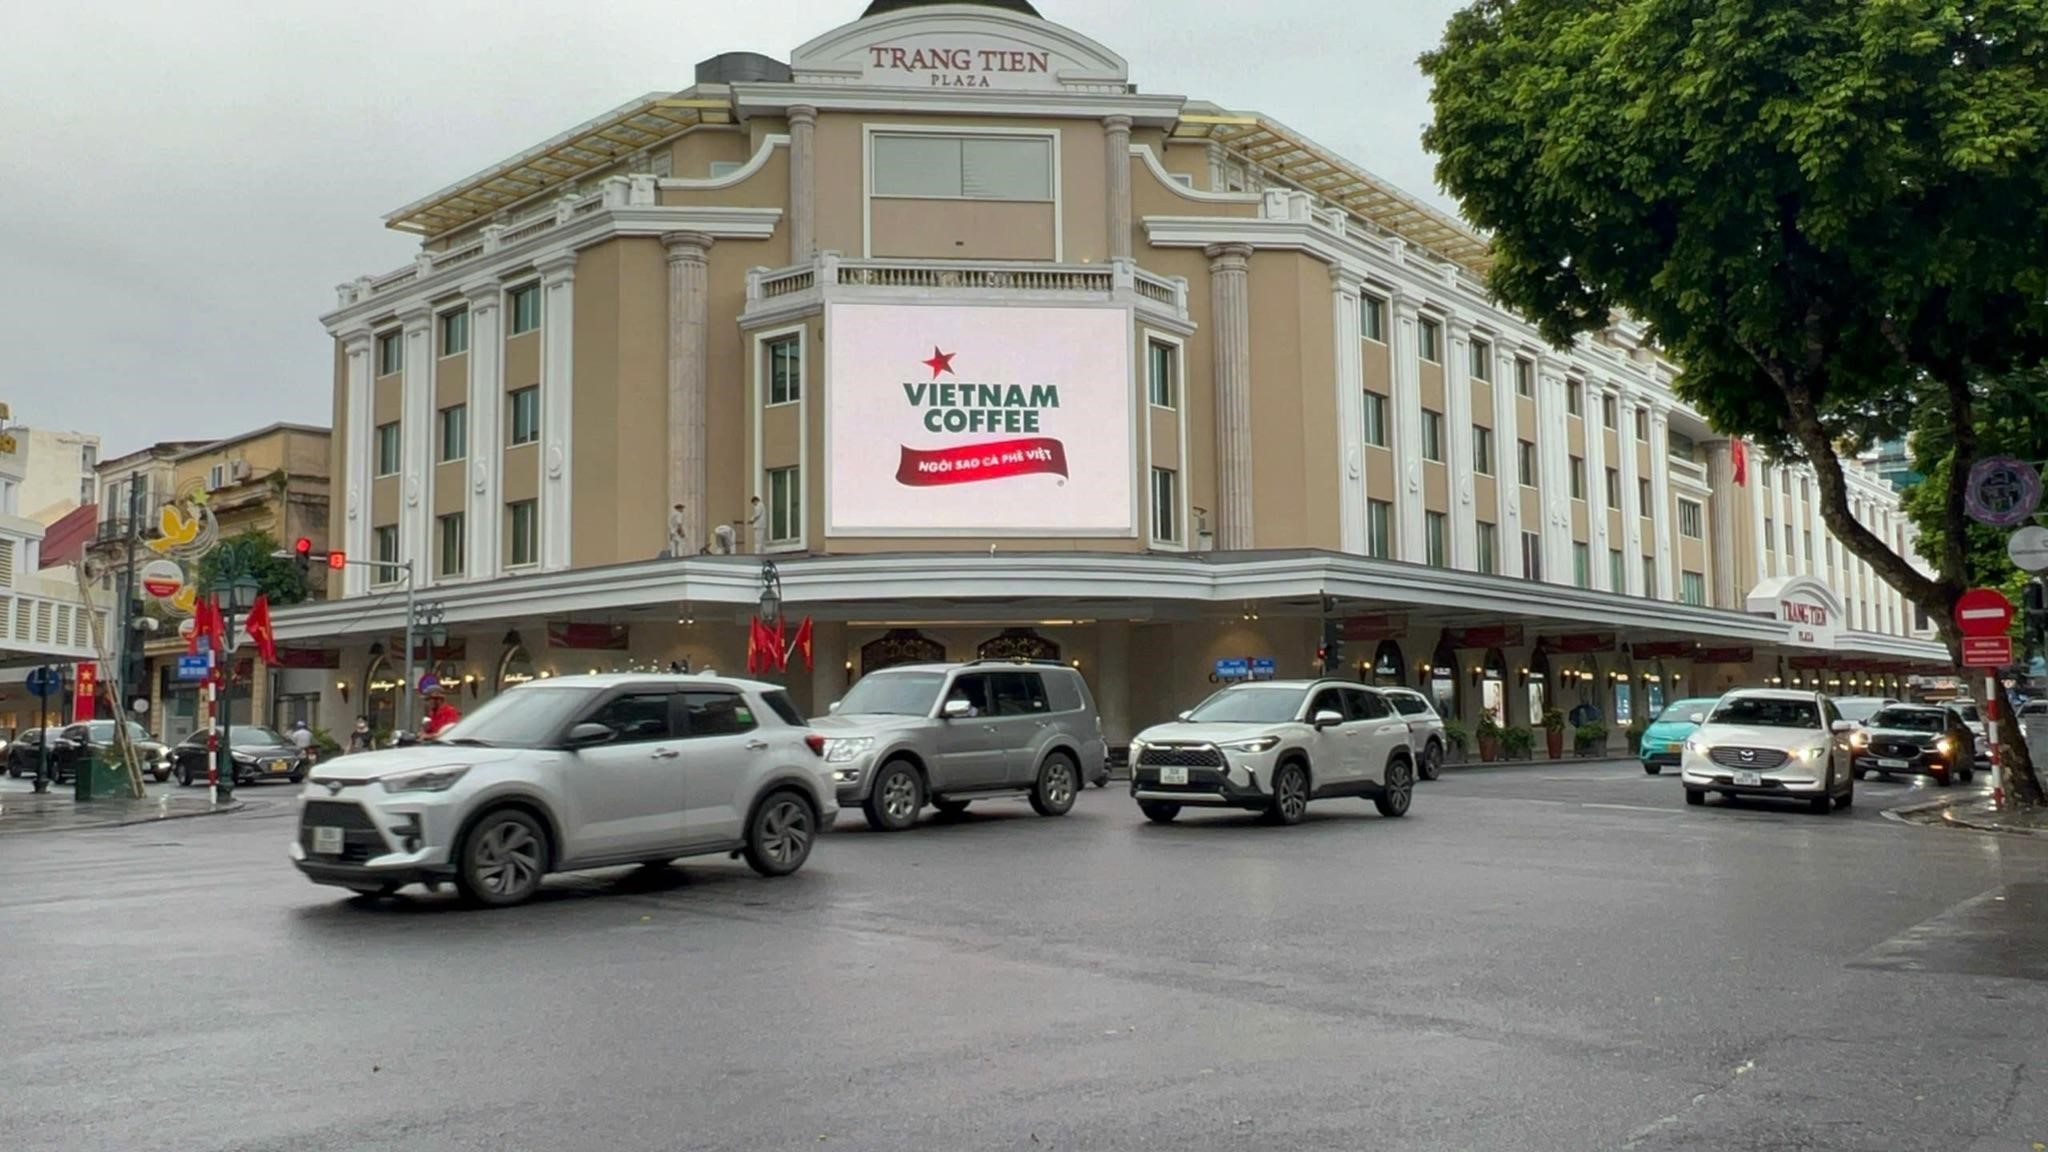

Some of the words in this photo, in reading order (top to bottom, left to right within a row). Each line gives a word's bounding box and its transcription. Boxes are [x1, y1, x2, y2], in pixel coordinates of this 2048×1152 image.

[870, 47, 971, 72] TRANG
[978, 50, 1049, 72] TIEN
[931, 74, 990, 87] PLAZA
[903, 382, 1060, 408] VIETNAM
[924, 408, 1039, 433] COFFEE
[918, 460, 952, 473] NGÔI
[955, 457, 980, 471] SAO
[1002, 452, 1024, 464] PHÊ
